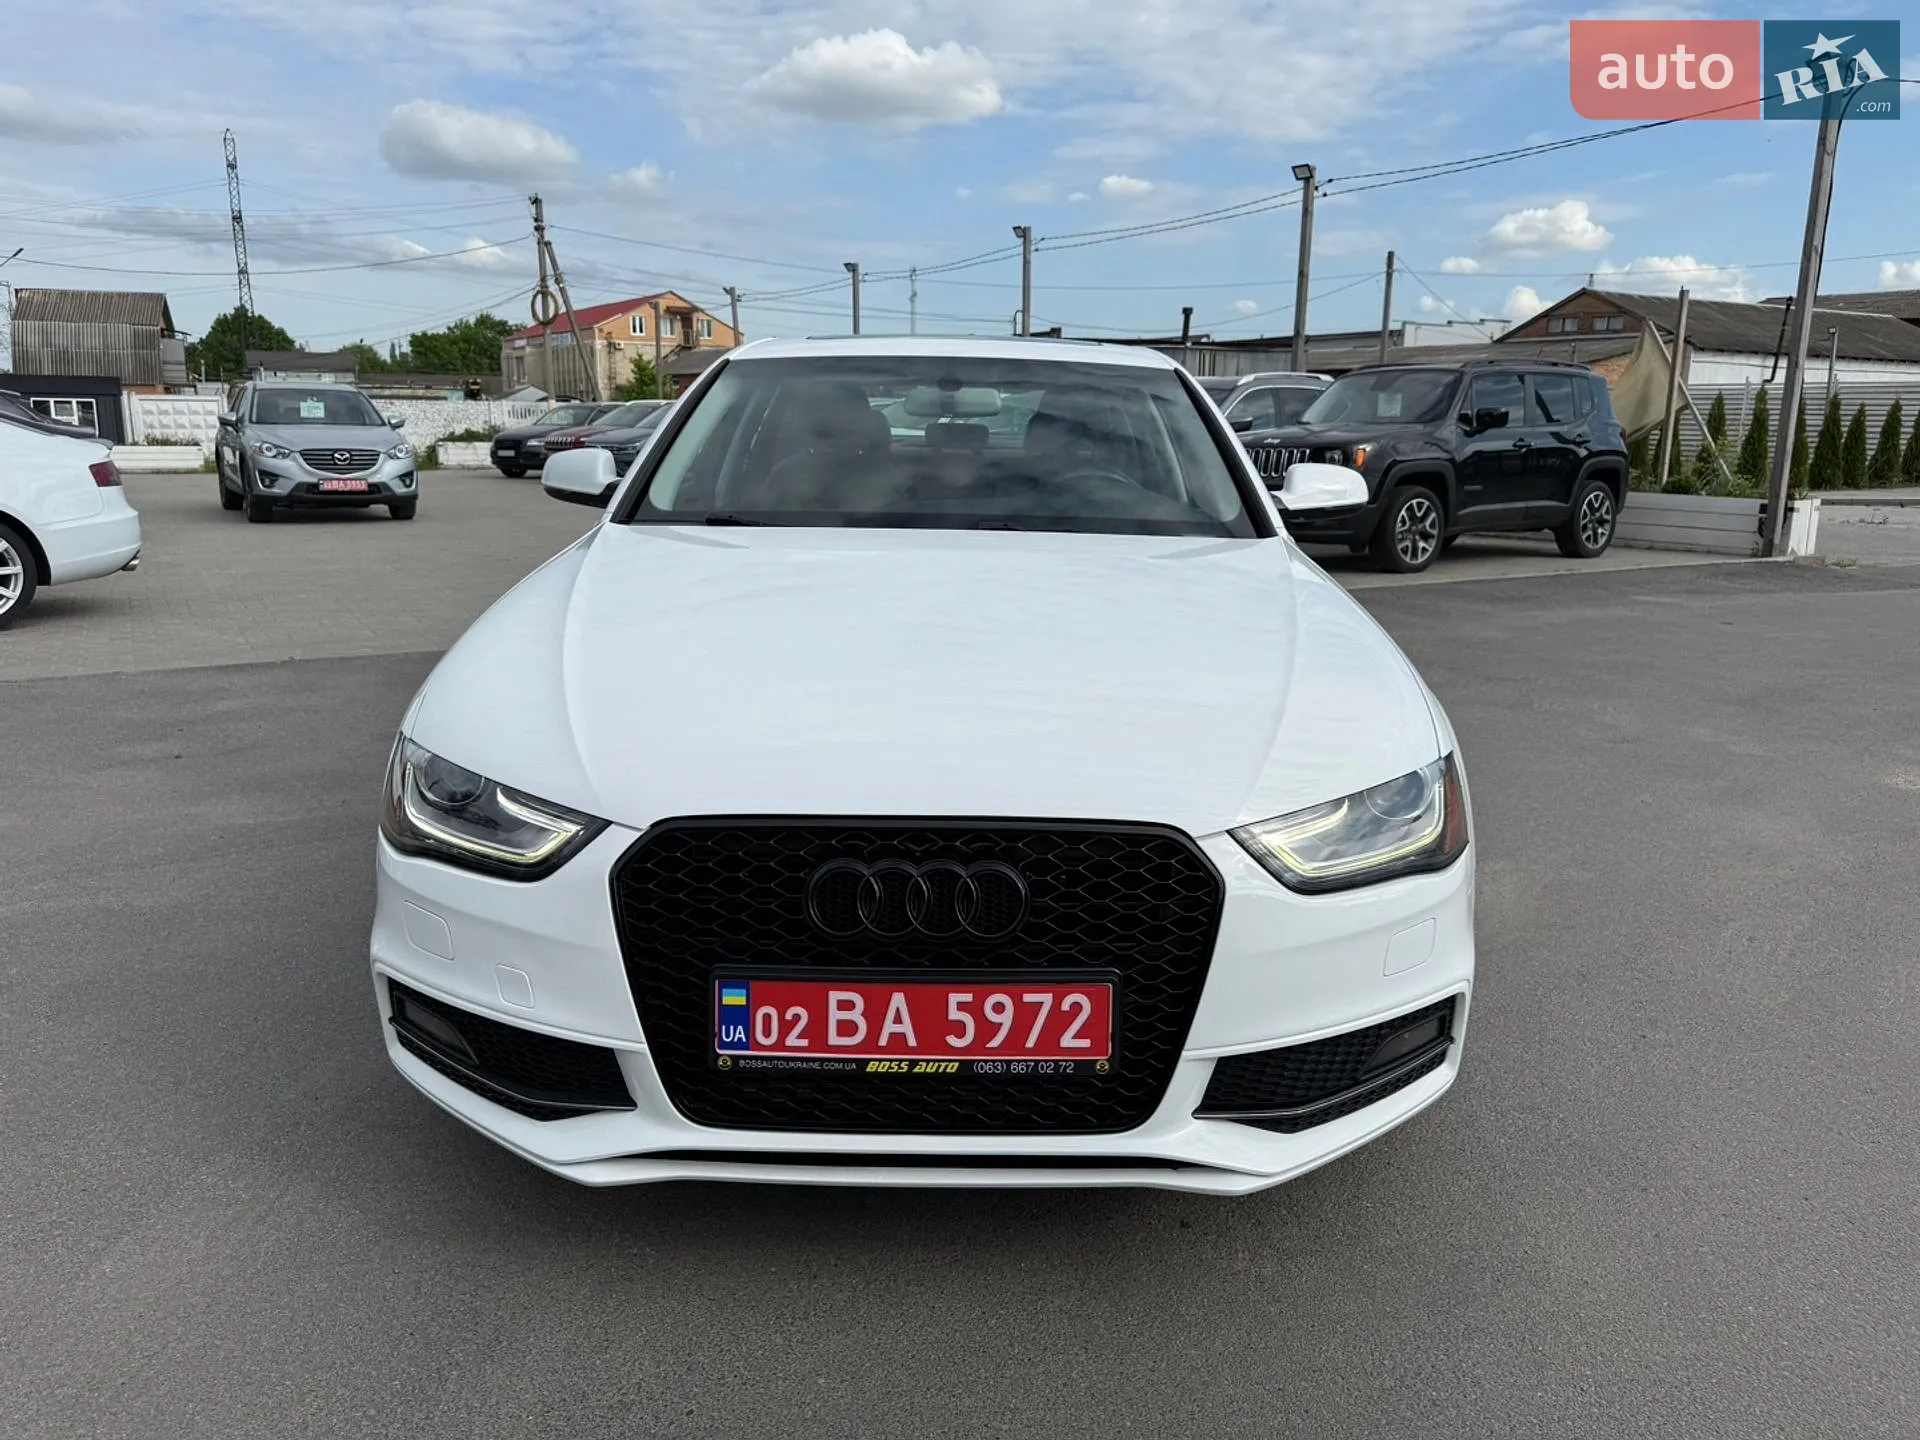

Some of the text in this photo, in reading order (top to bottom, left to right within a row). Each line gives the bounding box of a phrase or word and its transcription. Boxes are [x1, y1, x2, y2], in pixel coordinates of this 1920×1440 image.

[755, 991, 1092, 1048] 02 BA 5972
[722, 1025, 746, 1042] UA
[738, 1059, 857, 1070] BOSSAUTOUKRAINE.COM.UA
[866, 1061, 960, 1073] BOSS AUTO
[973, 1062, 1075, 1074] (063) 667 02 72
